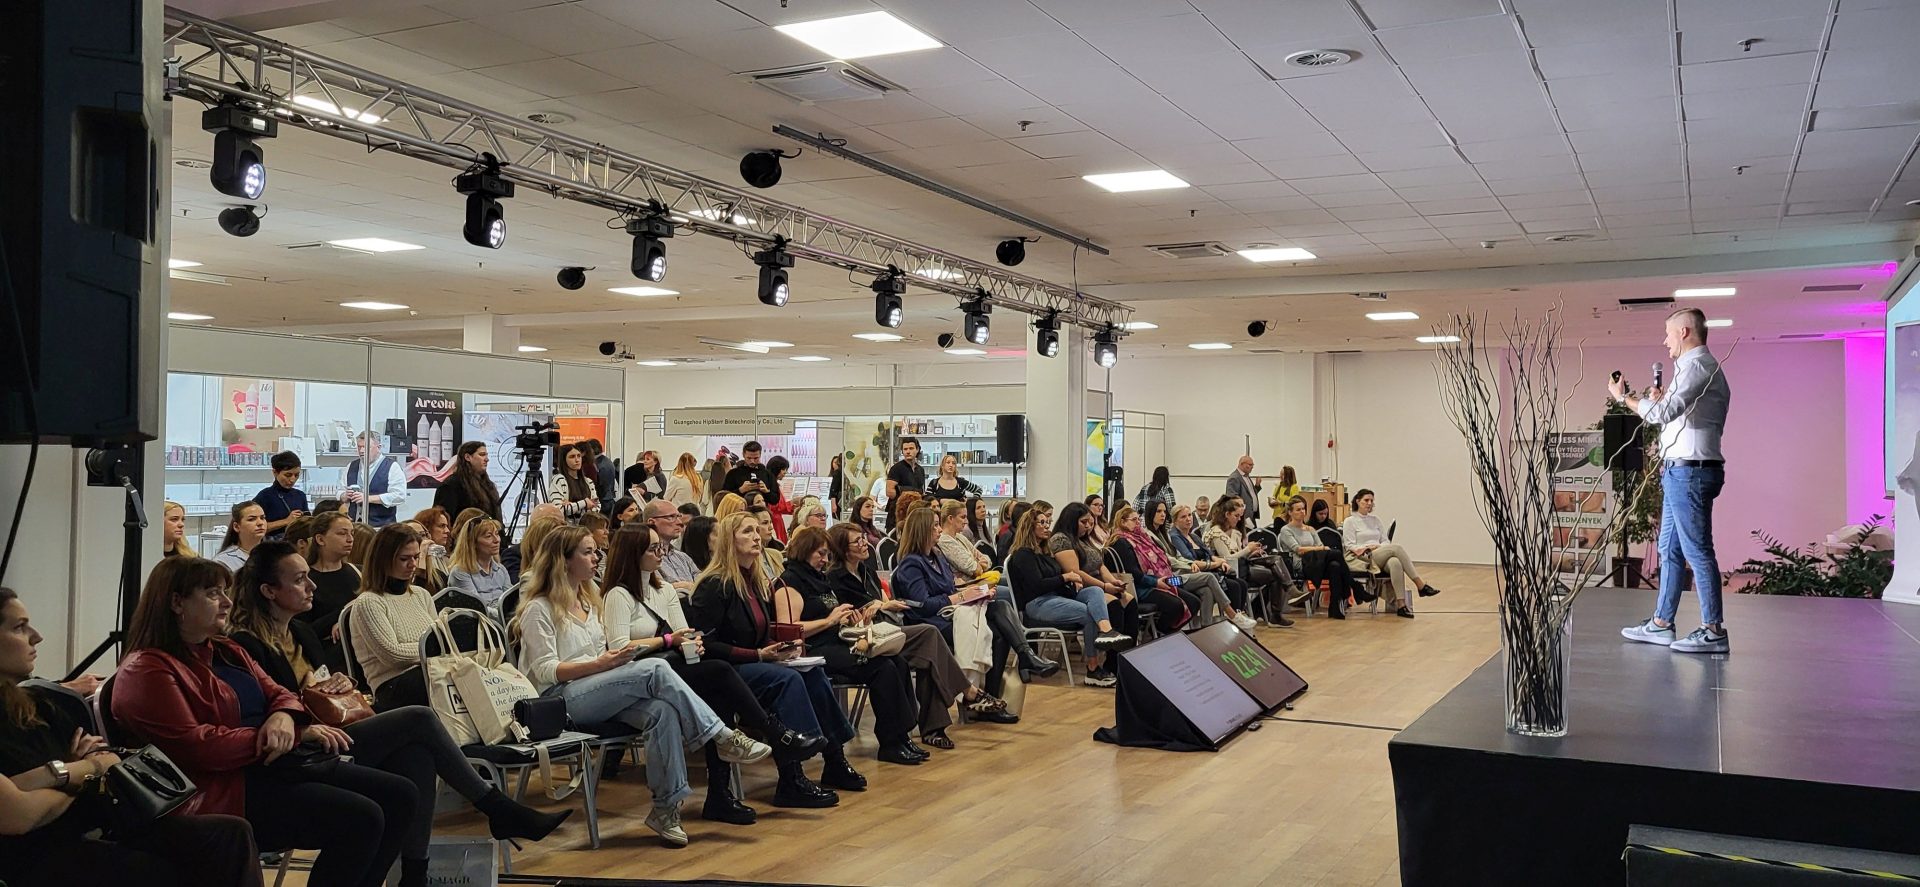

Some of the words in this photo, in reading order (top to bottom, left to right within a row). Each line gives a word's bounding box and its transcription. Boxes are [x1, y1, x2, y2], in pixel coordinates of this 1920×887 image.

[415, 397, 456, 409] Areola
[724, 418, 761, 426] Biotechnoloy
[1220, 644, 1271, 679] 22:41
[496, 686, 511, 696] day
[495, 698, 508, 707] the
